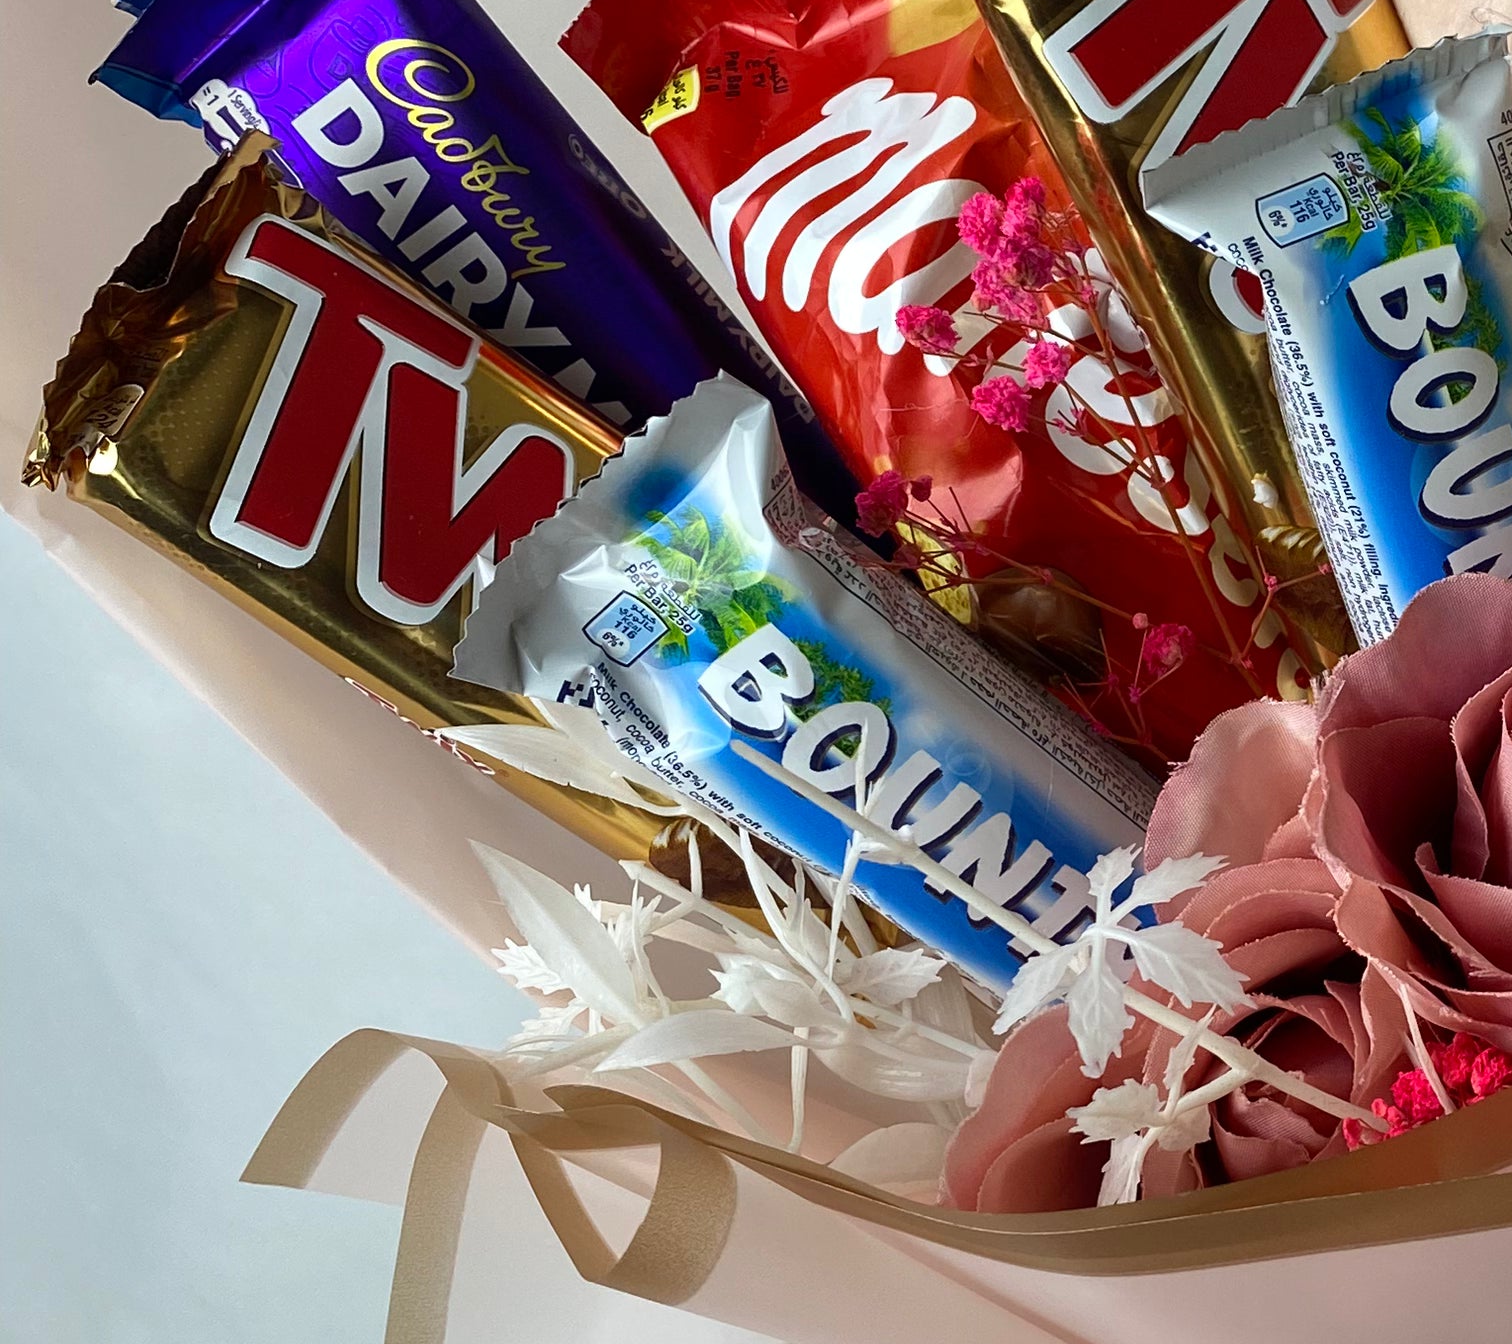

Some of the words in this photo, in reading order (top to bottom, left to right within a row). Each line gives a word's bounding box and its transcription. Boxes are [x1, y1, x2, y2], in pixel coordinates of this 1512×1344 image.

[722, 49, 740, 74] Per
[366, 39, 566, 276] Cadbury
[1329, 150, 1350, 175] Per
[1341, 175, 1364, 205] Bar,
[1356, 203, 1377, 232] 25g
[292, 79, 572, 348] DAIRY
[1287, 198, 1310, 224] 116
[1301, 196, 1319, 218] Kcal
[1320, 185, 1344, 213] كيلو
[1241, 233, 1267, 267] Milk
[1256, 267, 1295, 337] Chocolate
[1283, 338, 1315, 389] (36.5%)
[1305, 390, 1326, 419] with
[1317, 420, 1337, 449] soft
[1328, 449, 1356, 502] coconut
[1346, 502, 1371, 540] (21%)
[1290, 379, 1310, 417] cocoa
[1321, 460, 1348, 515] skimmed
[611, 618, 638, 641] 116
[619, 614, 643, 634] Kcal
[622, 561, 648, 589] Per
[640, 583, 672, 616] Bar,
[667, 608, 696, 636] 25g
[617, 689, 672, 751] Chocolate
[661, 747, 708, 793] (36.5%)
[706, 788, 736, 813] with
[735, 810, 763, 832] soft
[623, 721, 656, 757] cocoa
[698, 623, 1142, 983] BOUNT
